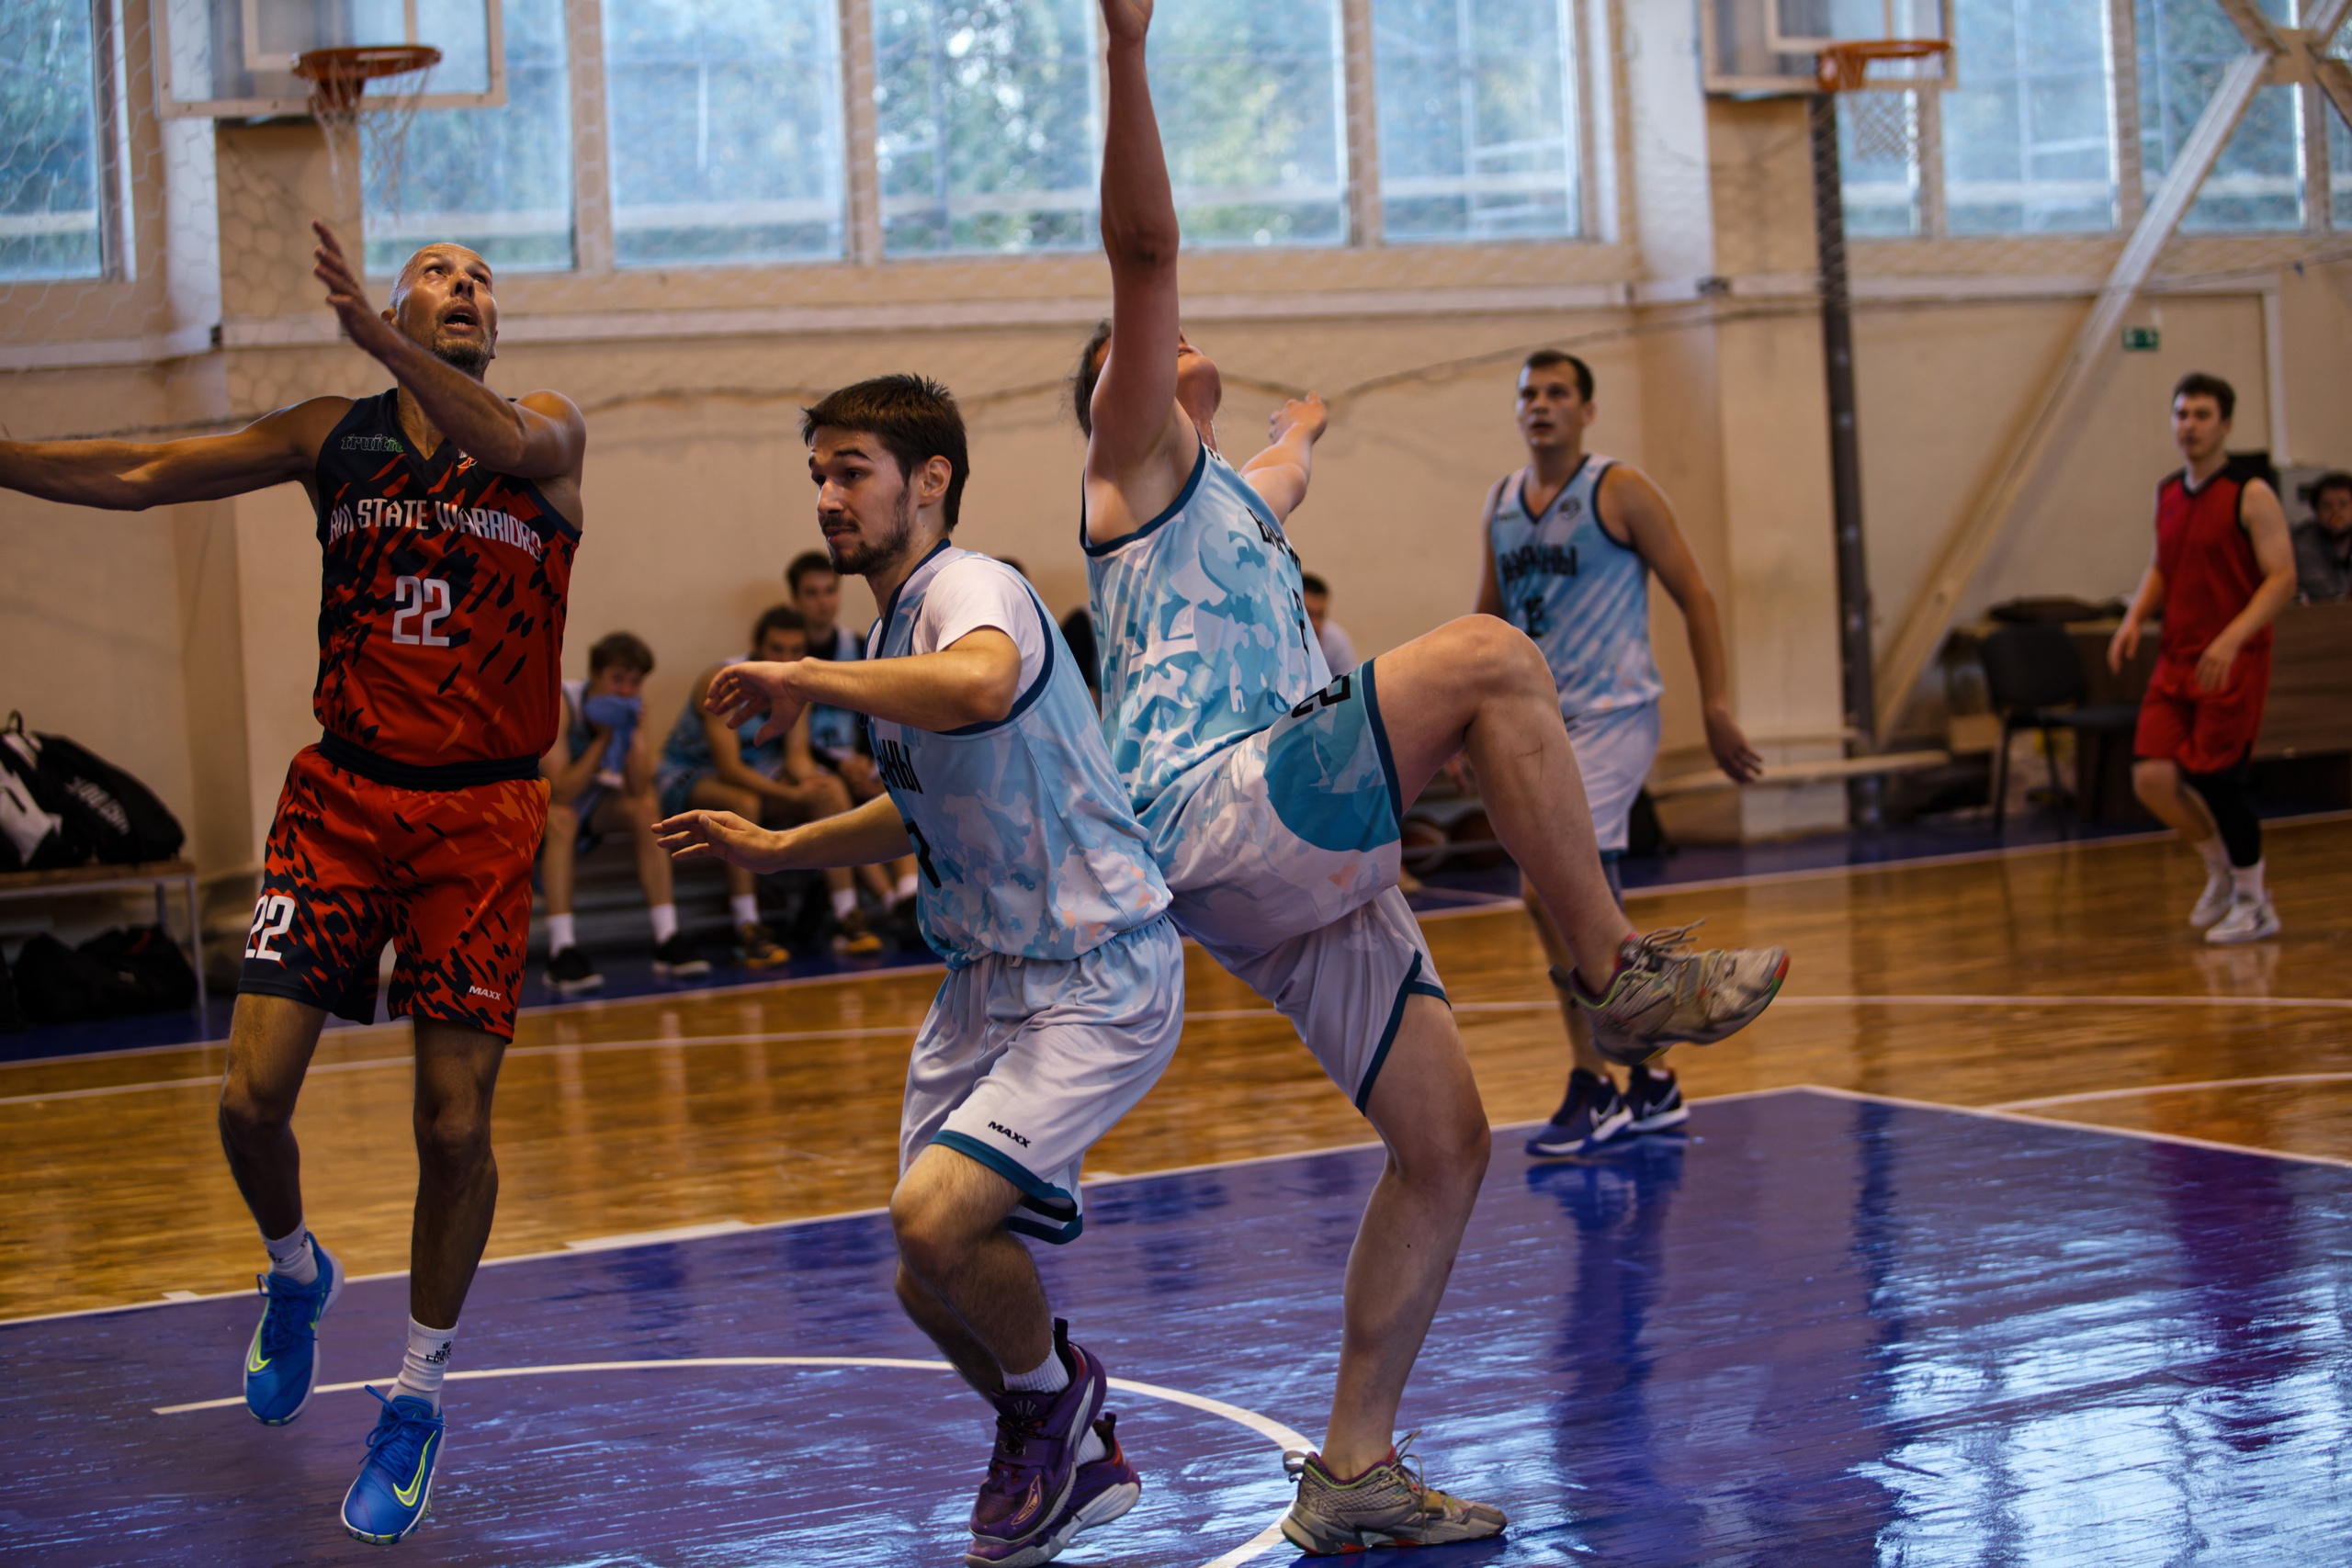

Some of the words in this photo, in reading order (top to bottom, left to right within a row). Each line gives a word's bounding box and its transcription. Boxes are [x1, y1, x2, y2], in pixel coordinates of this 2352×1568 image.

[357, 498, 429, 531] STATE
[435, 501, 542, 562] WARRIORS
[392, 575, 451, 647] 22
[244, 895, 296, 962] 22
[469, 985, 502, 1001] MAXX
[988, 1121, 1032, 1149] MAXX
